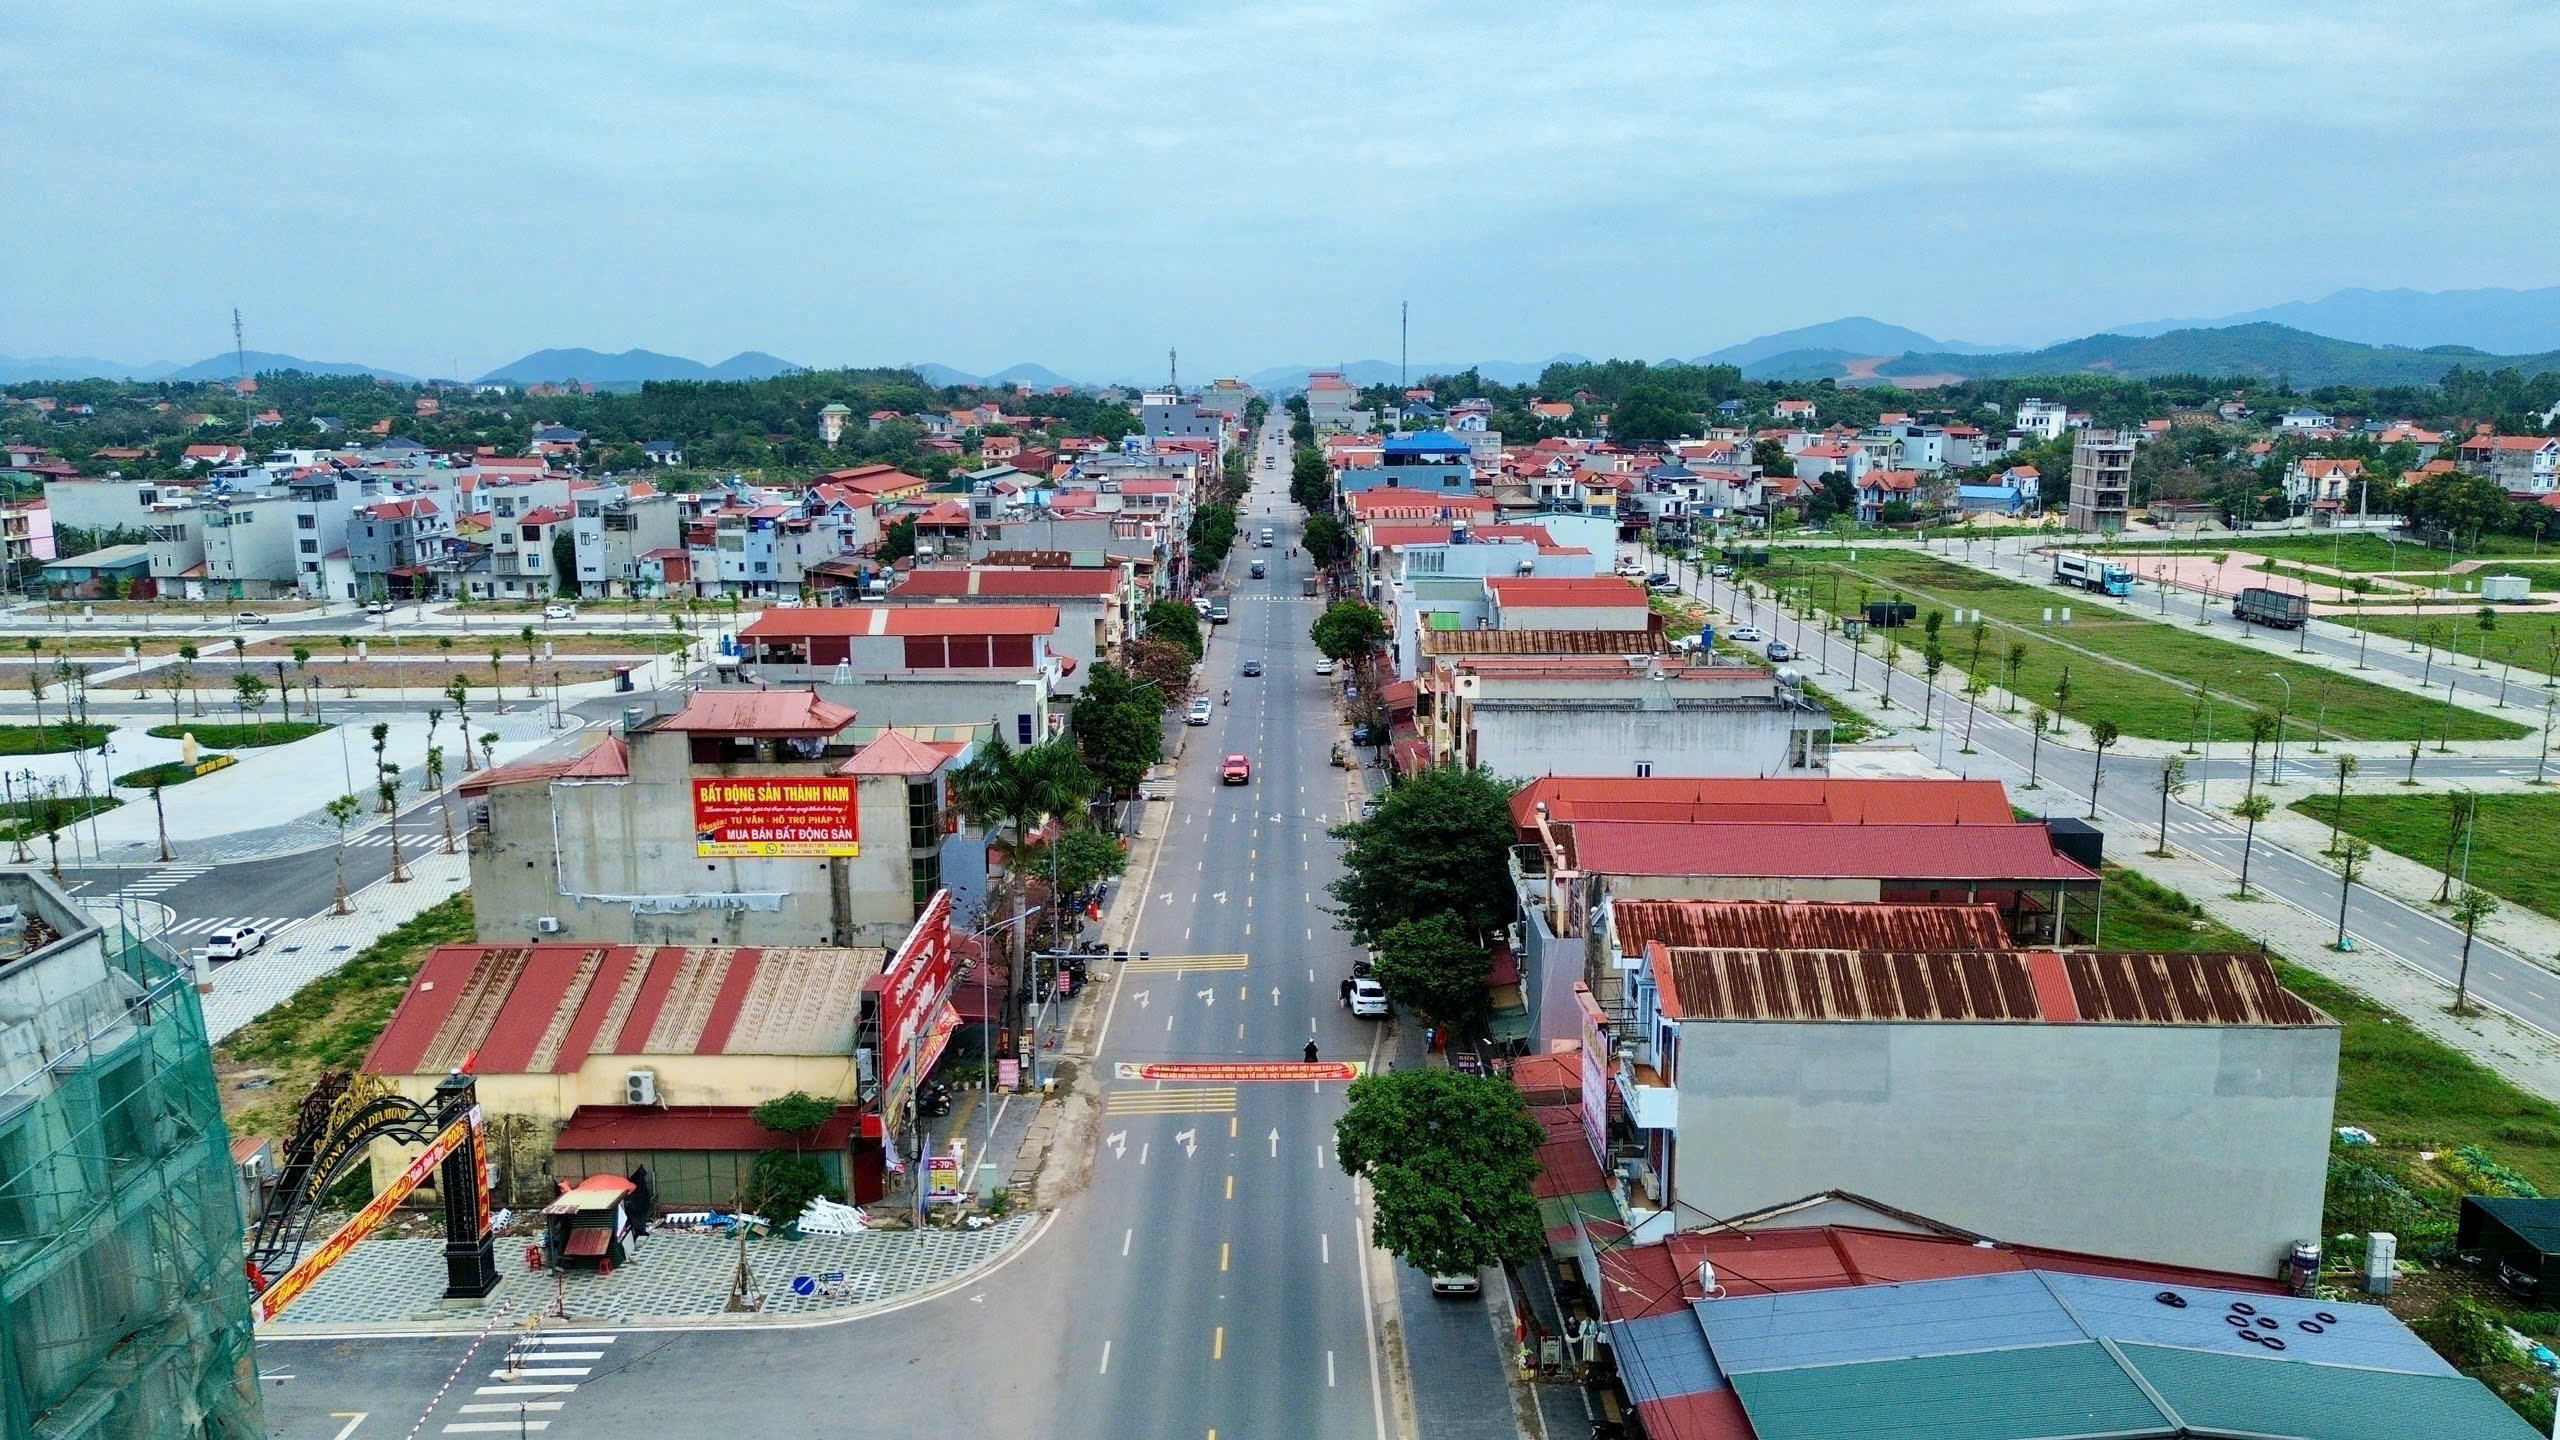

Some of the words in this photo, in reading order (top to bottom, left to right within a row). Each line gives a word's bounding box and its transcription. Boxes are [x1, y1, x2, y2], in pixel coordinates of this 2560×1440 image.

[700, 782, 722, 802] BẤT
[724, 784, 756, 804] ĐỘNG
[758, 782, 782, 802] SẢN
[783, 784, 820, 802] THÀNH
[824, 786, 849, 802] NAM
[730, 816, 742, 824] TƯ
[745, 814, 764, 824] VẤN
[808, 814, 832, 824] PHÁP
[726, 829, 750, 840] MUA
[752, 828, 774, 840] BÁN
[776, 826, 796, 840] BẤT
[800, 828, 829, 842] ĐỘNG
[831, 826, 853, 840] SẢN
[368, 1107, 408, 1128] DIAMOND
[446, 1122, 465, 1146] 2026
